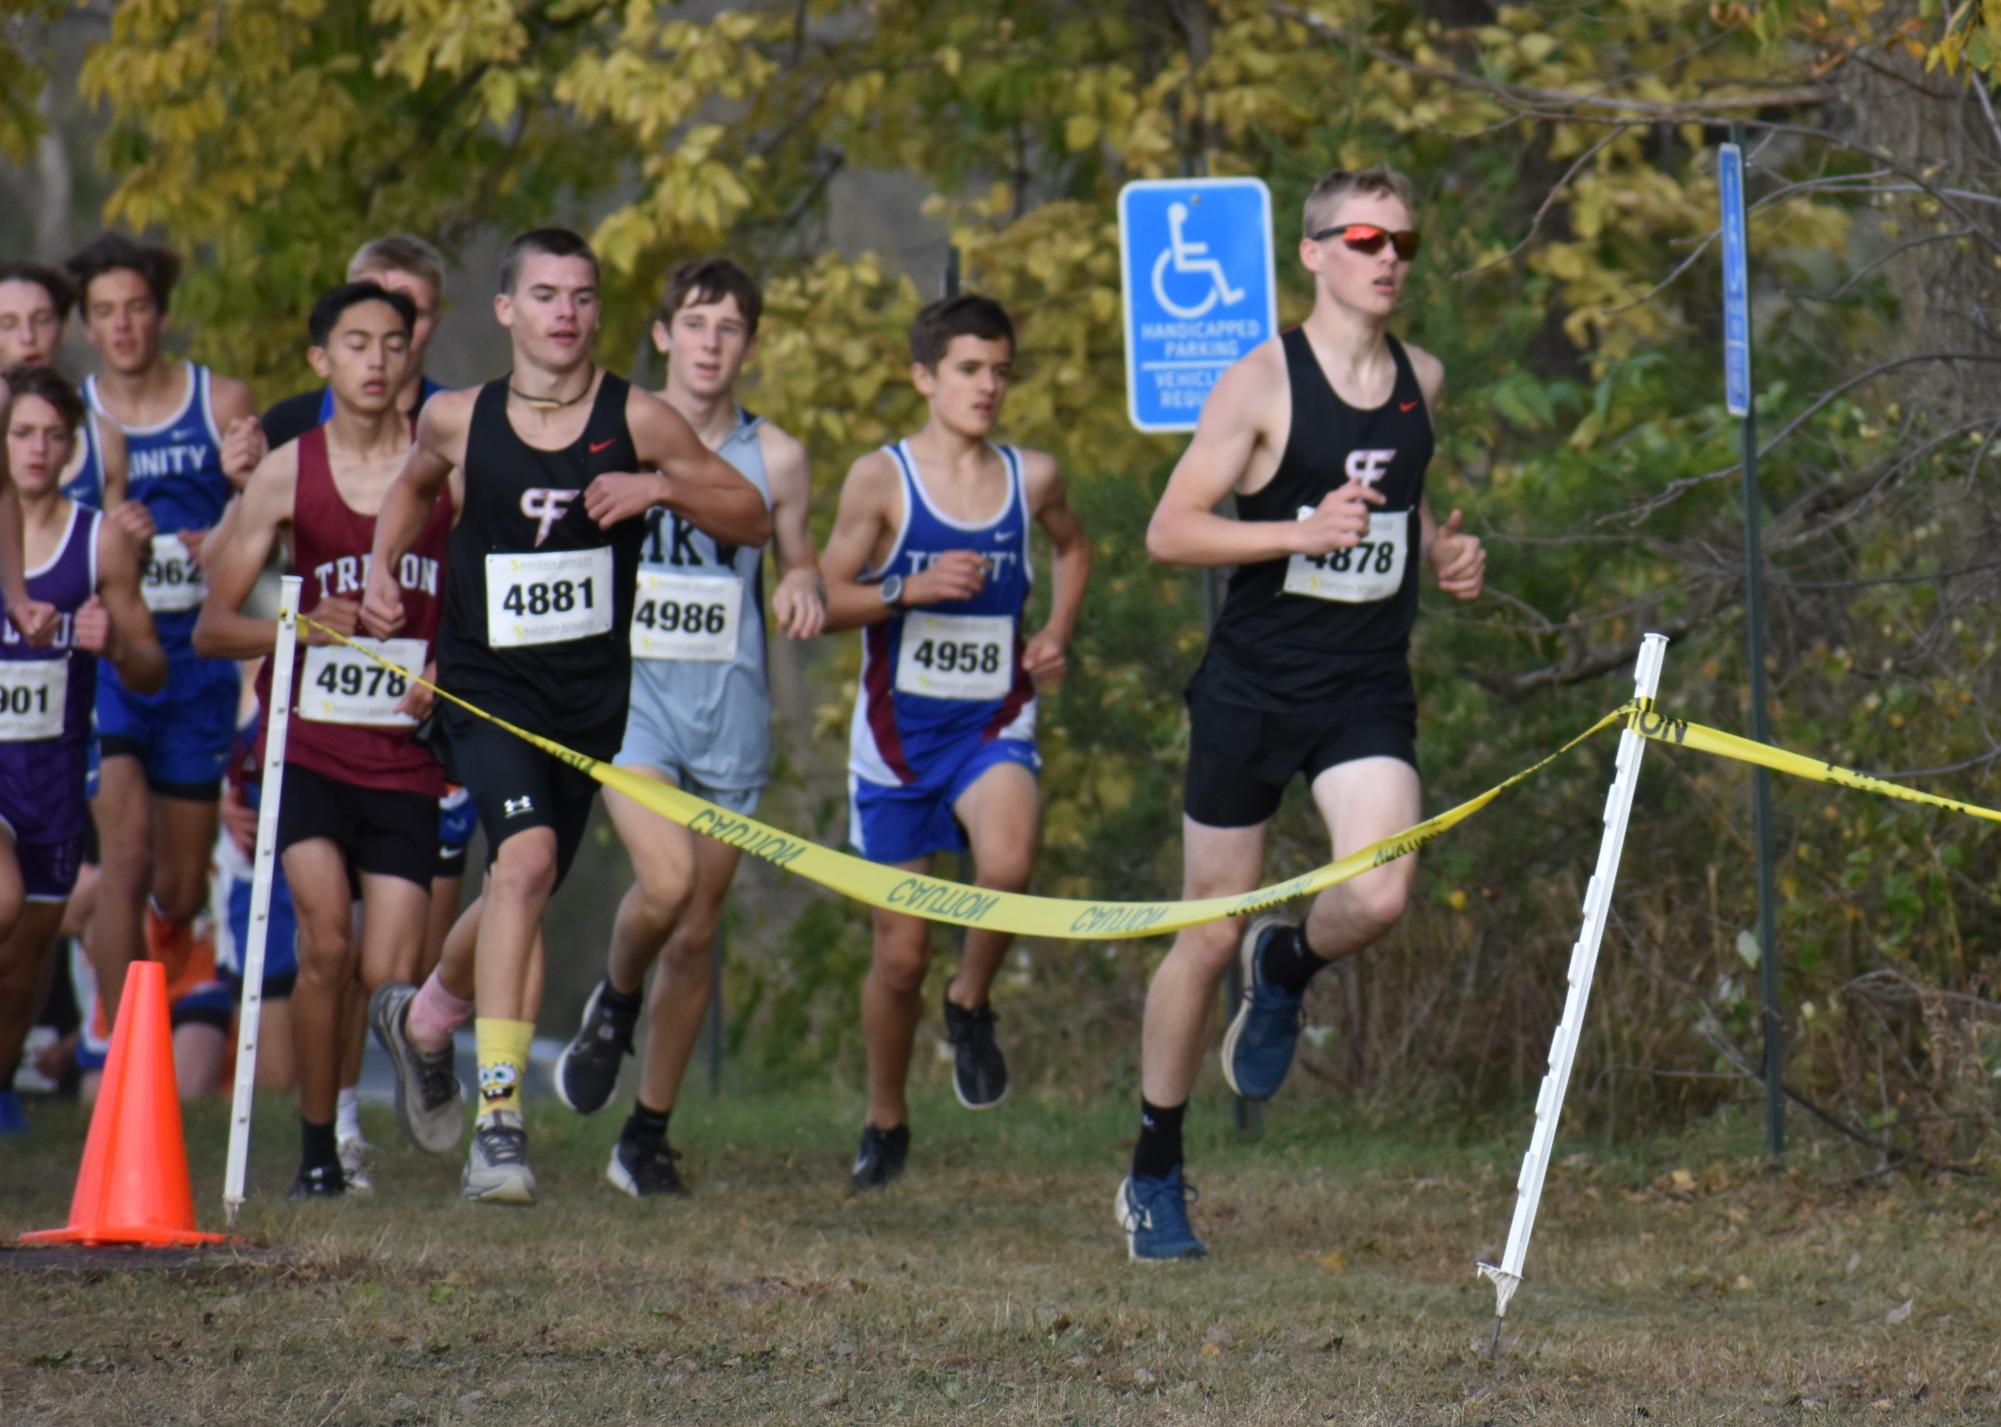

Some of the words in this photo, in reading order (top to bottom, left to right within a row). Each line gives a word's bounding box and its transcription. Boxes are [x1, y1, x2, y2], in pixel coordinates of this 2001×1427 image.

[1141, 320, 1260, 340] HANDICAPPED
[1164, 340, 1239, 358] PARKING
[315, 553, 438, 598] TRION
[503, 577, 594, 616] 4881
[636, 600, 725, 634] 4986
[914, 639, 1000, 673] 4958
[317, 662, 408, 697] 4978
